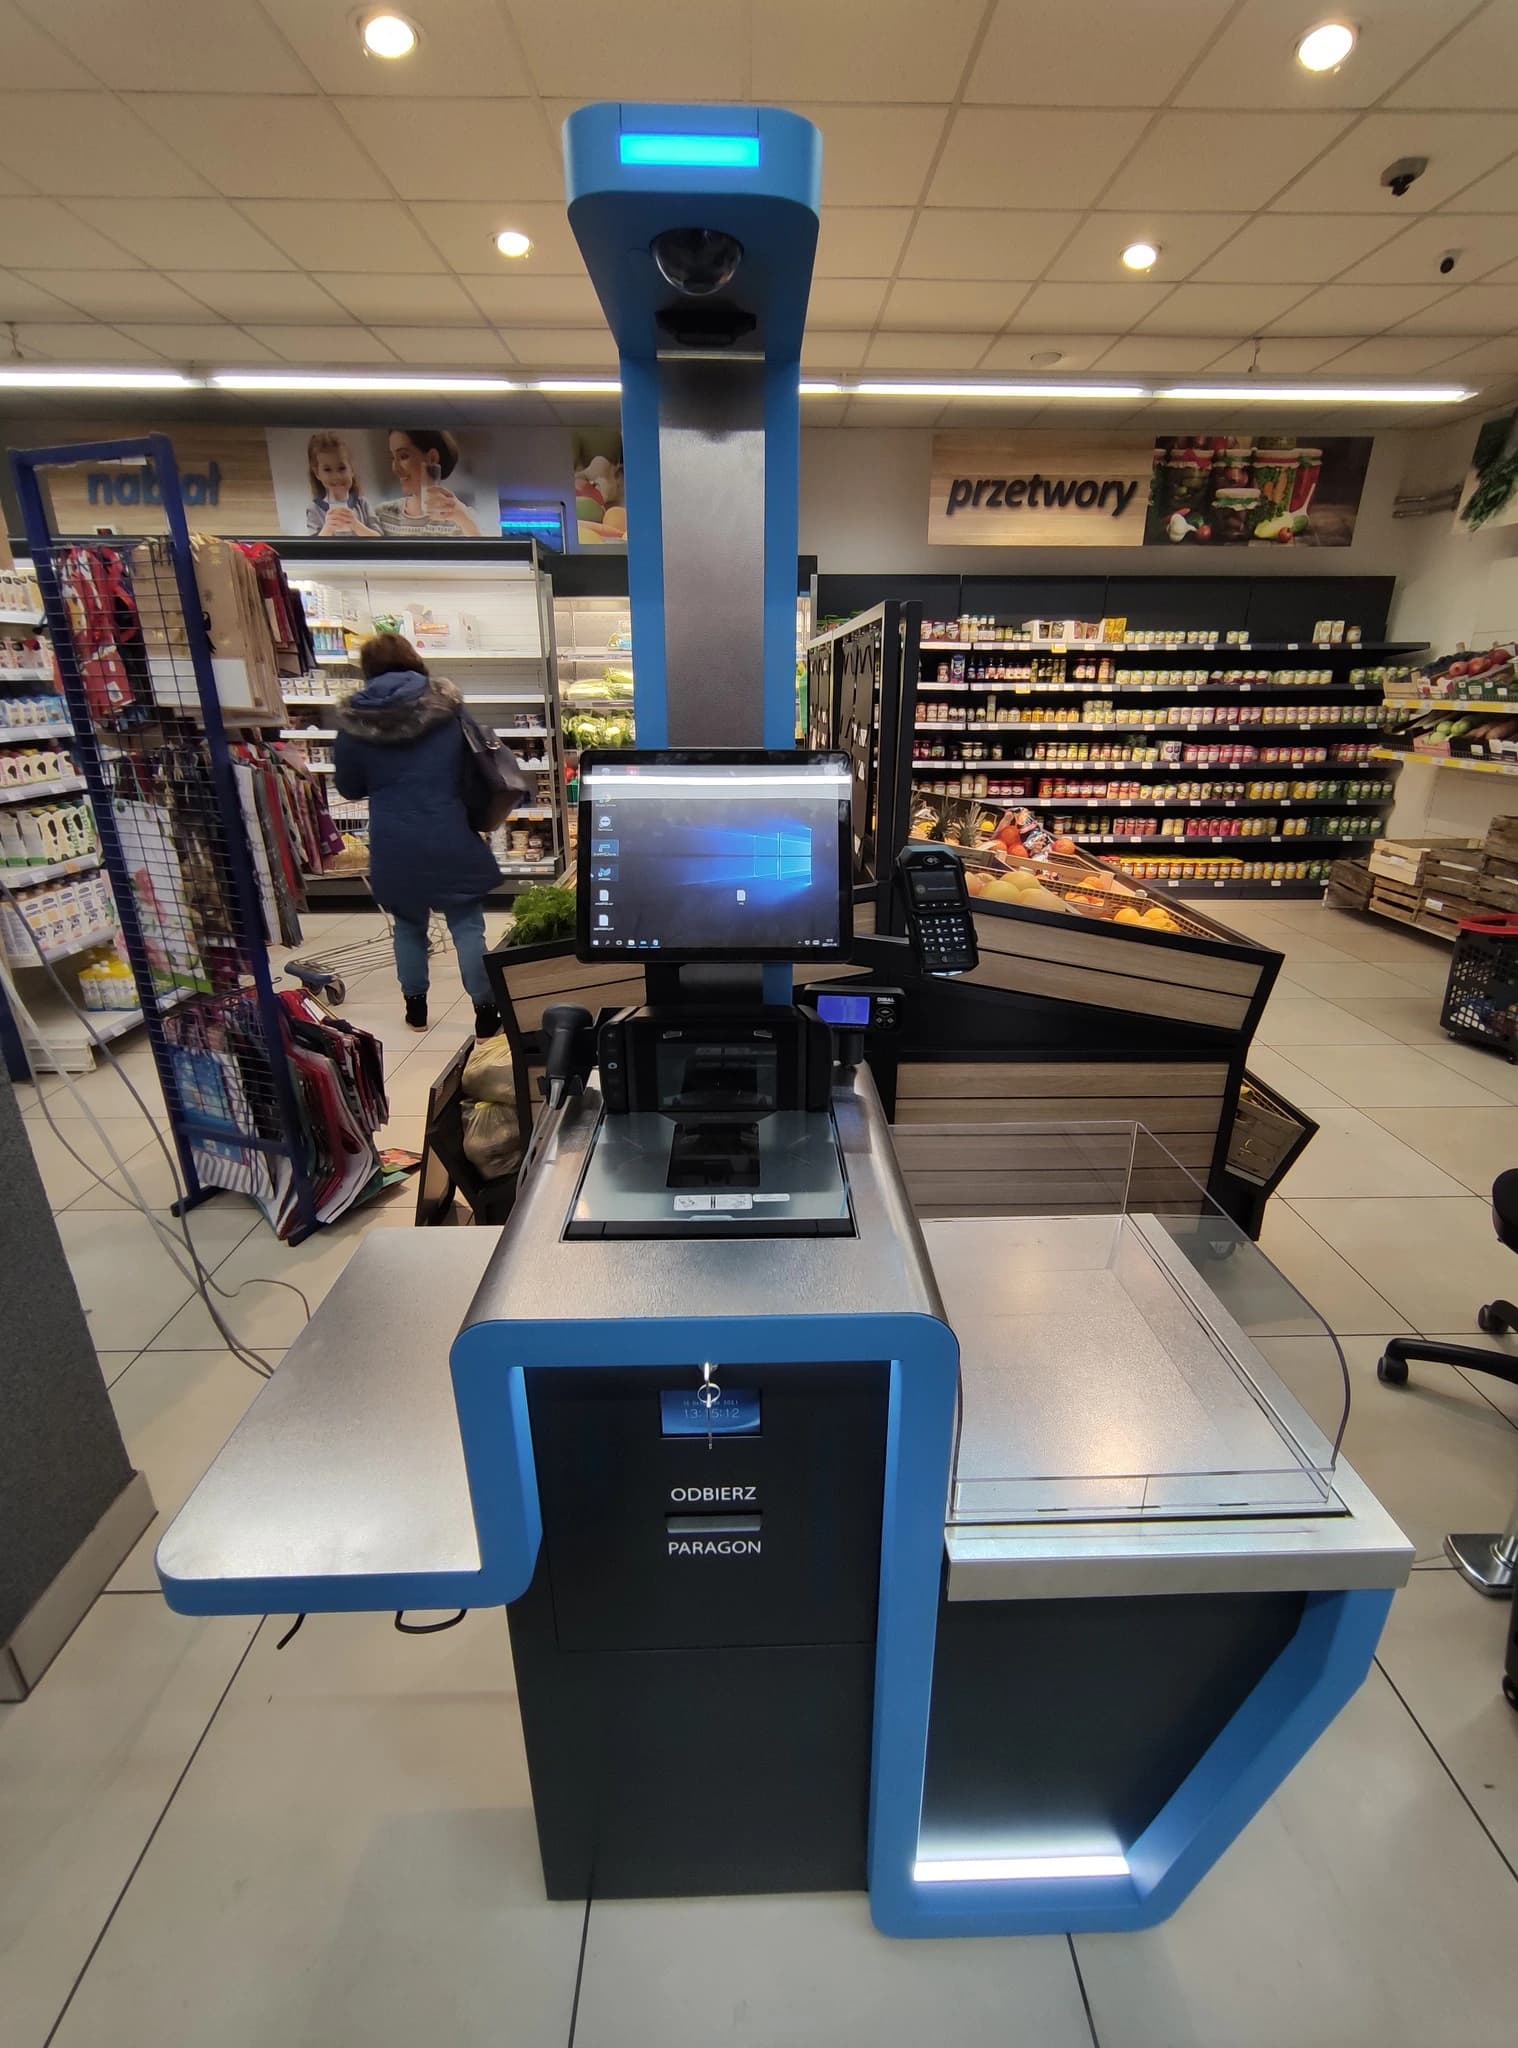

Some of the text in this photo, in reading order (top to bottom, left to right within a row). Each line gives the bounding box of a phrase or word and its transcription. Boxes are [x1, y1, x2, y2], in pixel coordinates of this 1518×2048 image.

[87, 461, 220, 506] nabał
[946, 474, 1138, 517] przetwory
[670, 1486, 757, 1502] ODBIERZ
[668, 1540, 761, 1555] PARAGON
